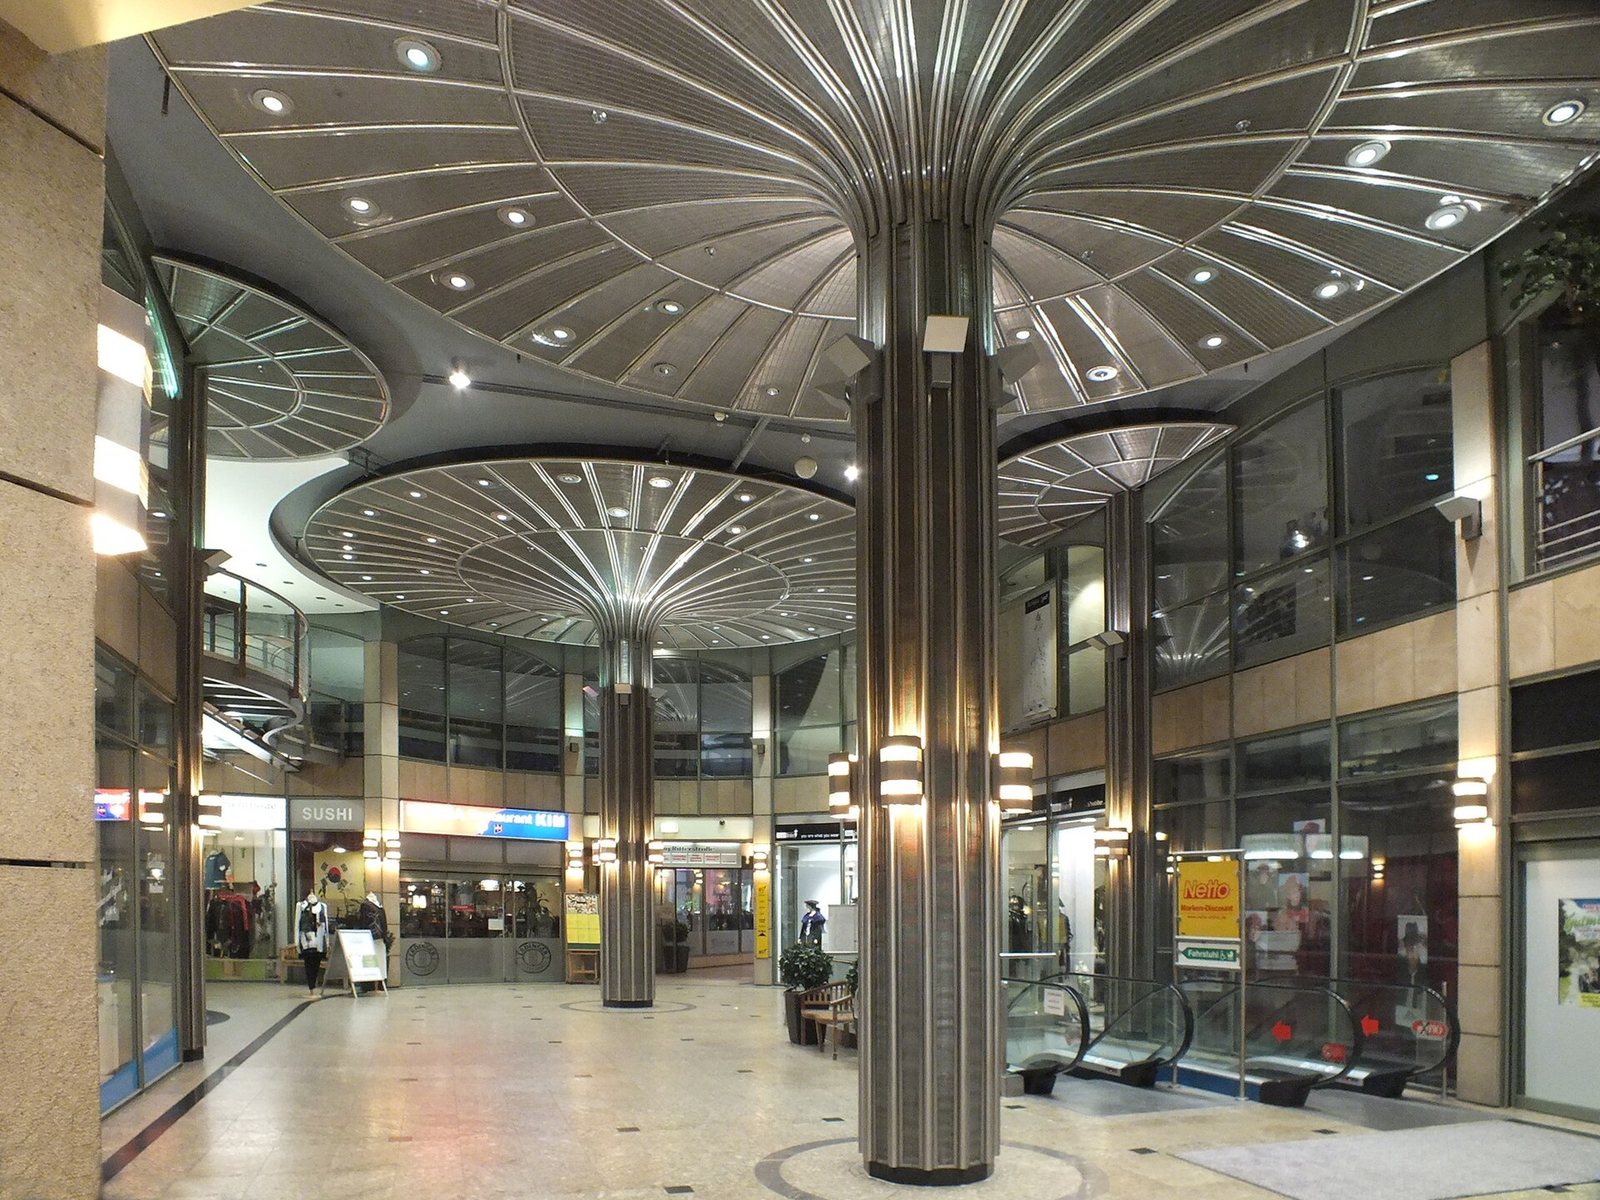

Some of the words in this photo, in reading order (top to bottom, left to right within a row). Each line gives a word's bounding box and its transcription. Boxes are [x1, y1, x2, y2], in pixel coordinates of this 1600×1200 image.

[302, 807, 353, 821] SUSHI
[535, 813, 566, 828] KIM
[1184, 880, 1230, 899] Netto
[1181, 904, 1234, 912] Marken-Discount
[1187, 948, 1219, 959] Fahrstuhl
